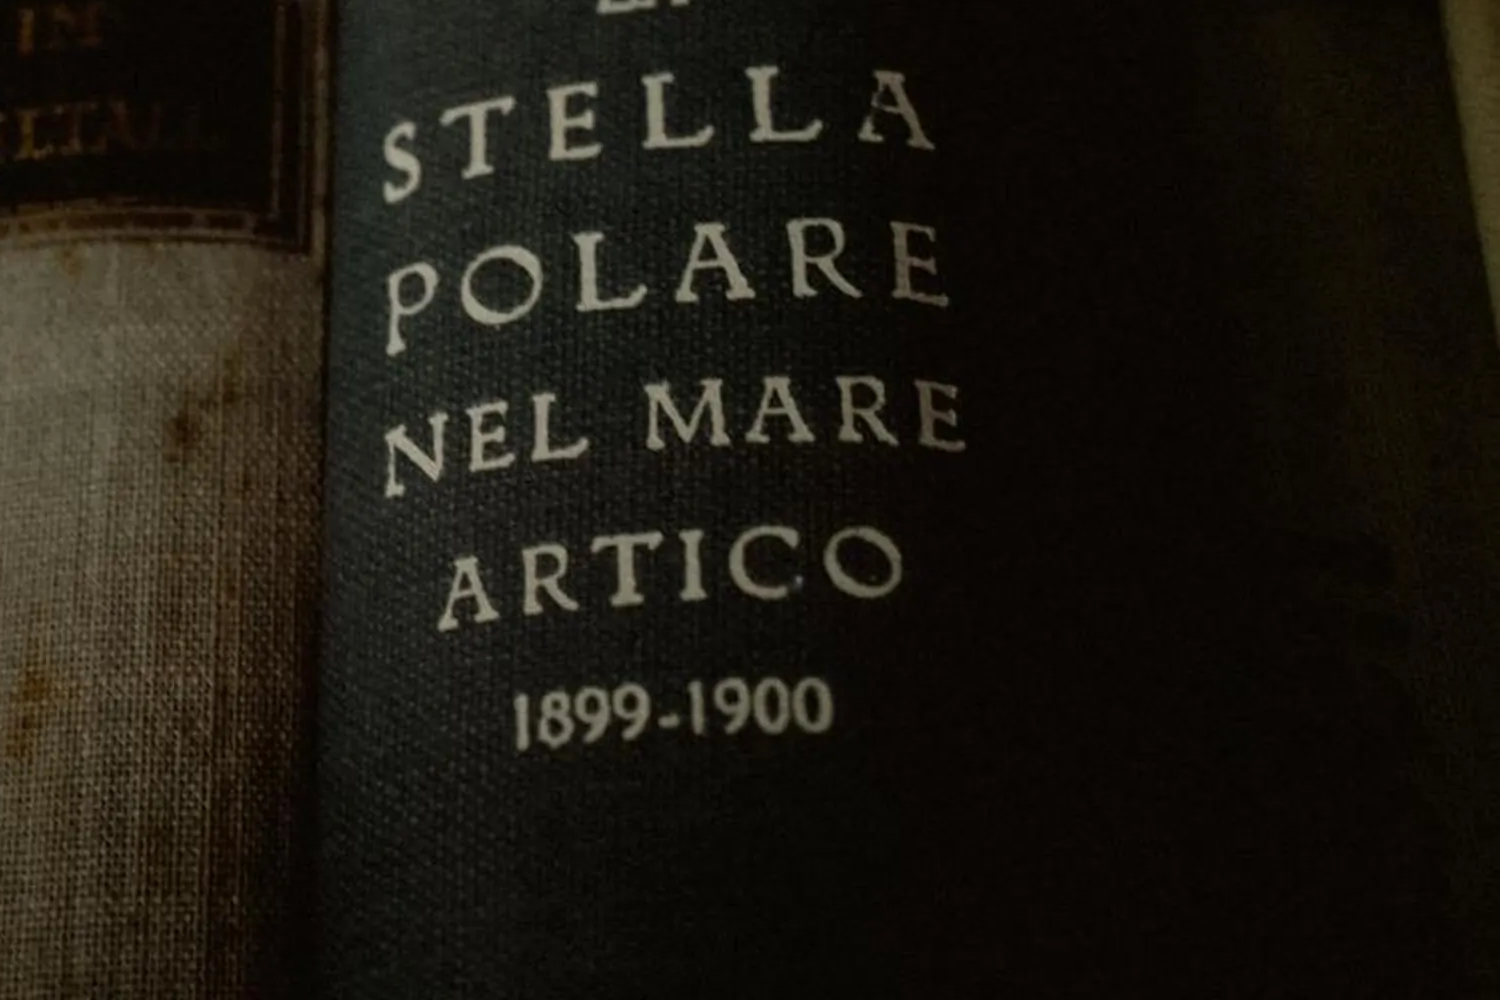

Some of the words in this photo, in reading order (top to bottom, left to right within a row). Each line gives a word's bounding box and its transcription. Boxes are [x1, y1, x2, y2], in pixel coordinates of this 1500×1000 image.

[15, 0, 104, 58] IM
[382, 65, 938, 204] STELLA
[384, 216, 951, 357] POLARE
[383, 393, 591, 498] NEL
[644, 375, 967, 452] MARE
[437, 524, 904, 631] ARTICO
[512, 676, 836, 753] 1899-1900
